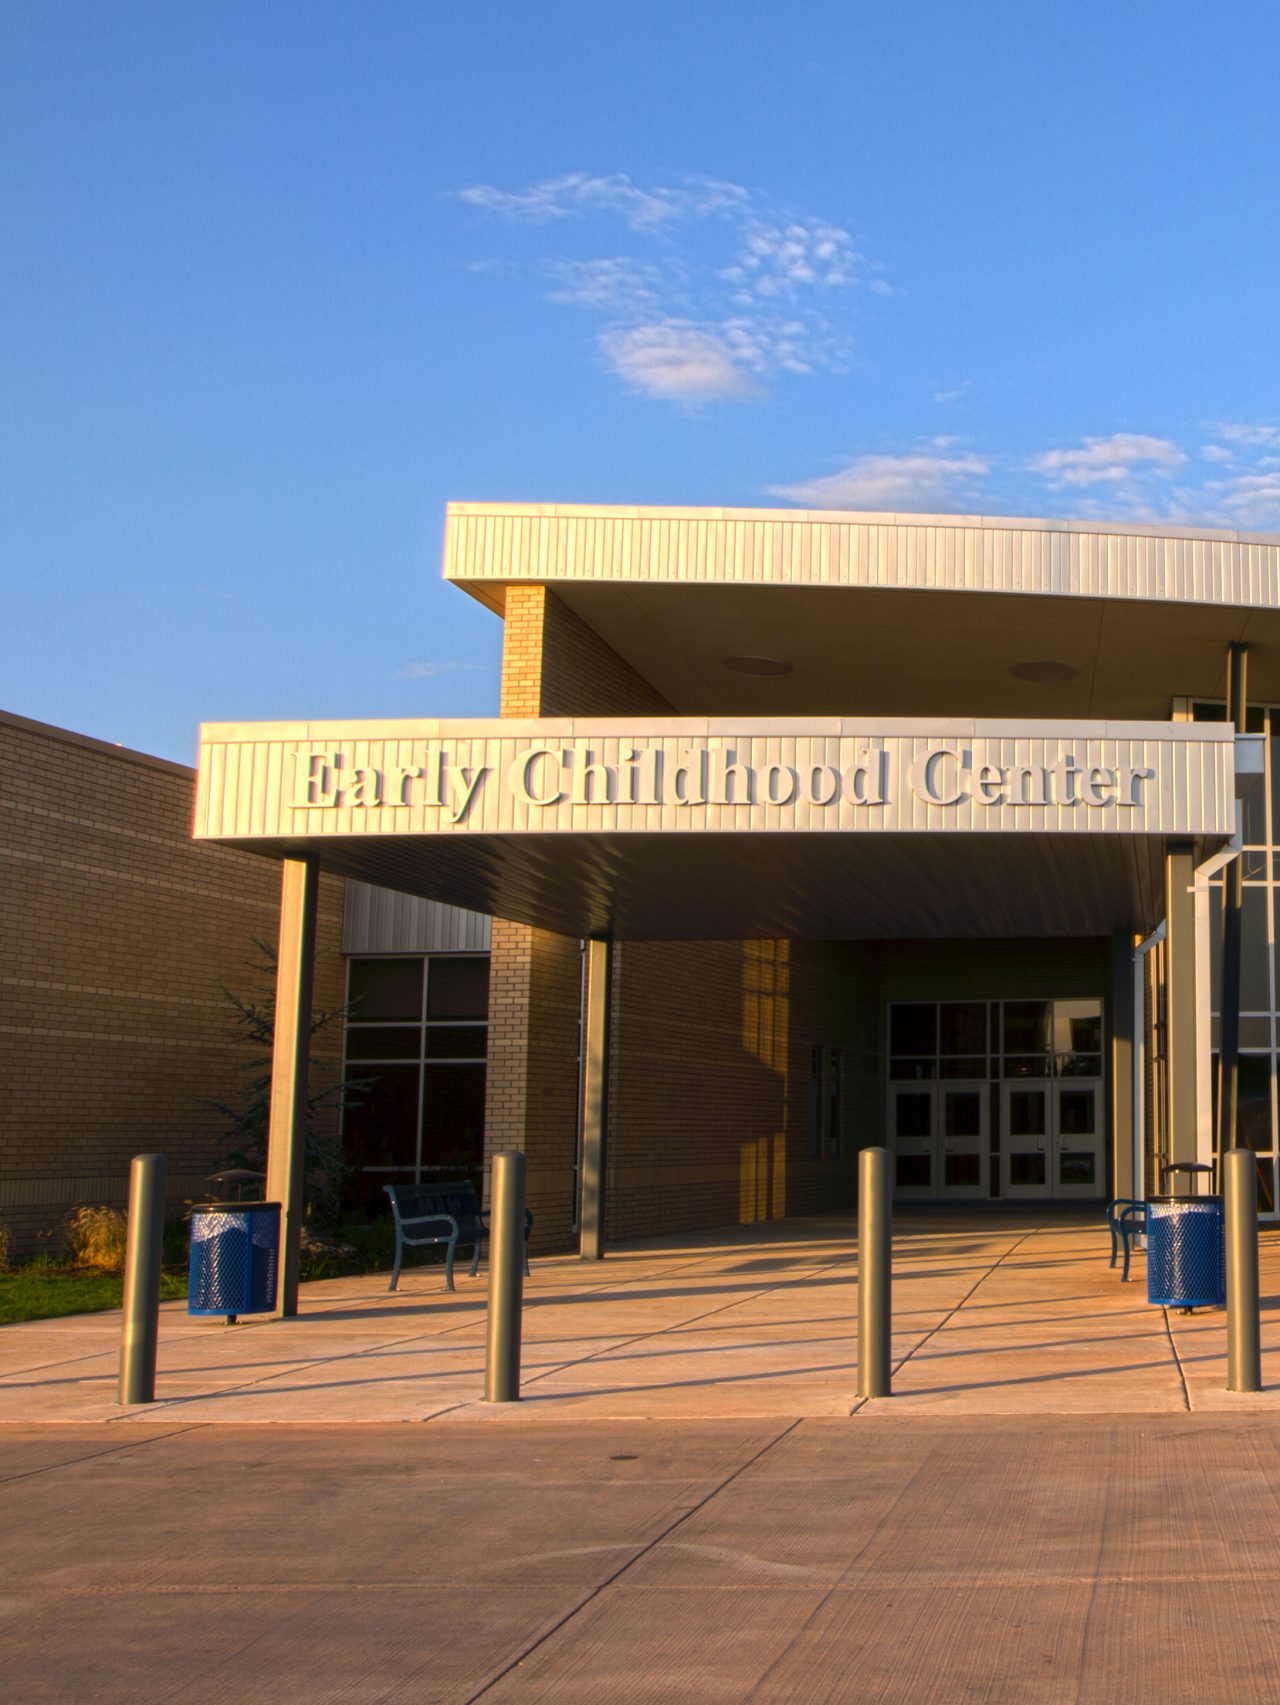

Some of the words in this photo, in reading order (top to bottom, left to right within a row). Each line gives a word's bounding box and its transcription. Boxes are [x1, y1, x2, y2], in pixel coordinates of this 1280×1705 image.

[288, 749, 493, 824] Early
[507, 747, 888, 806] Childhood
[908, 748, 1152, 808] Center
